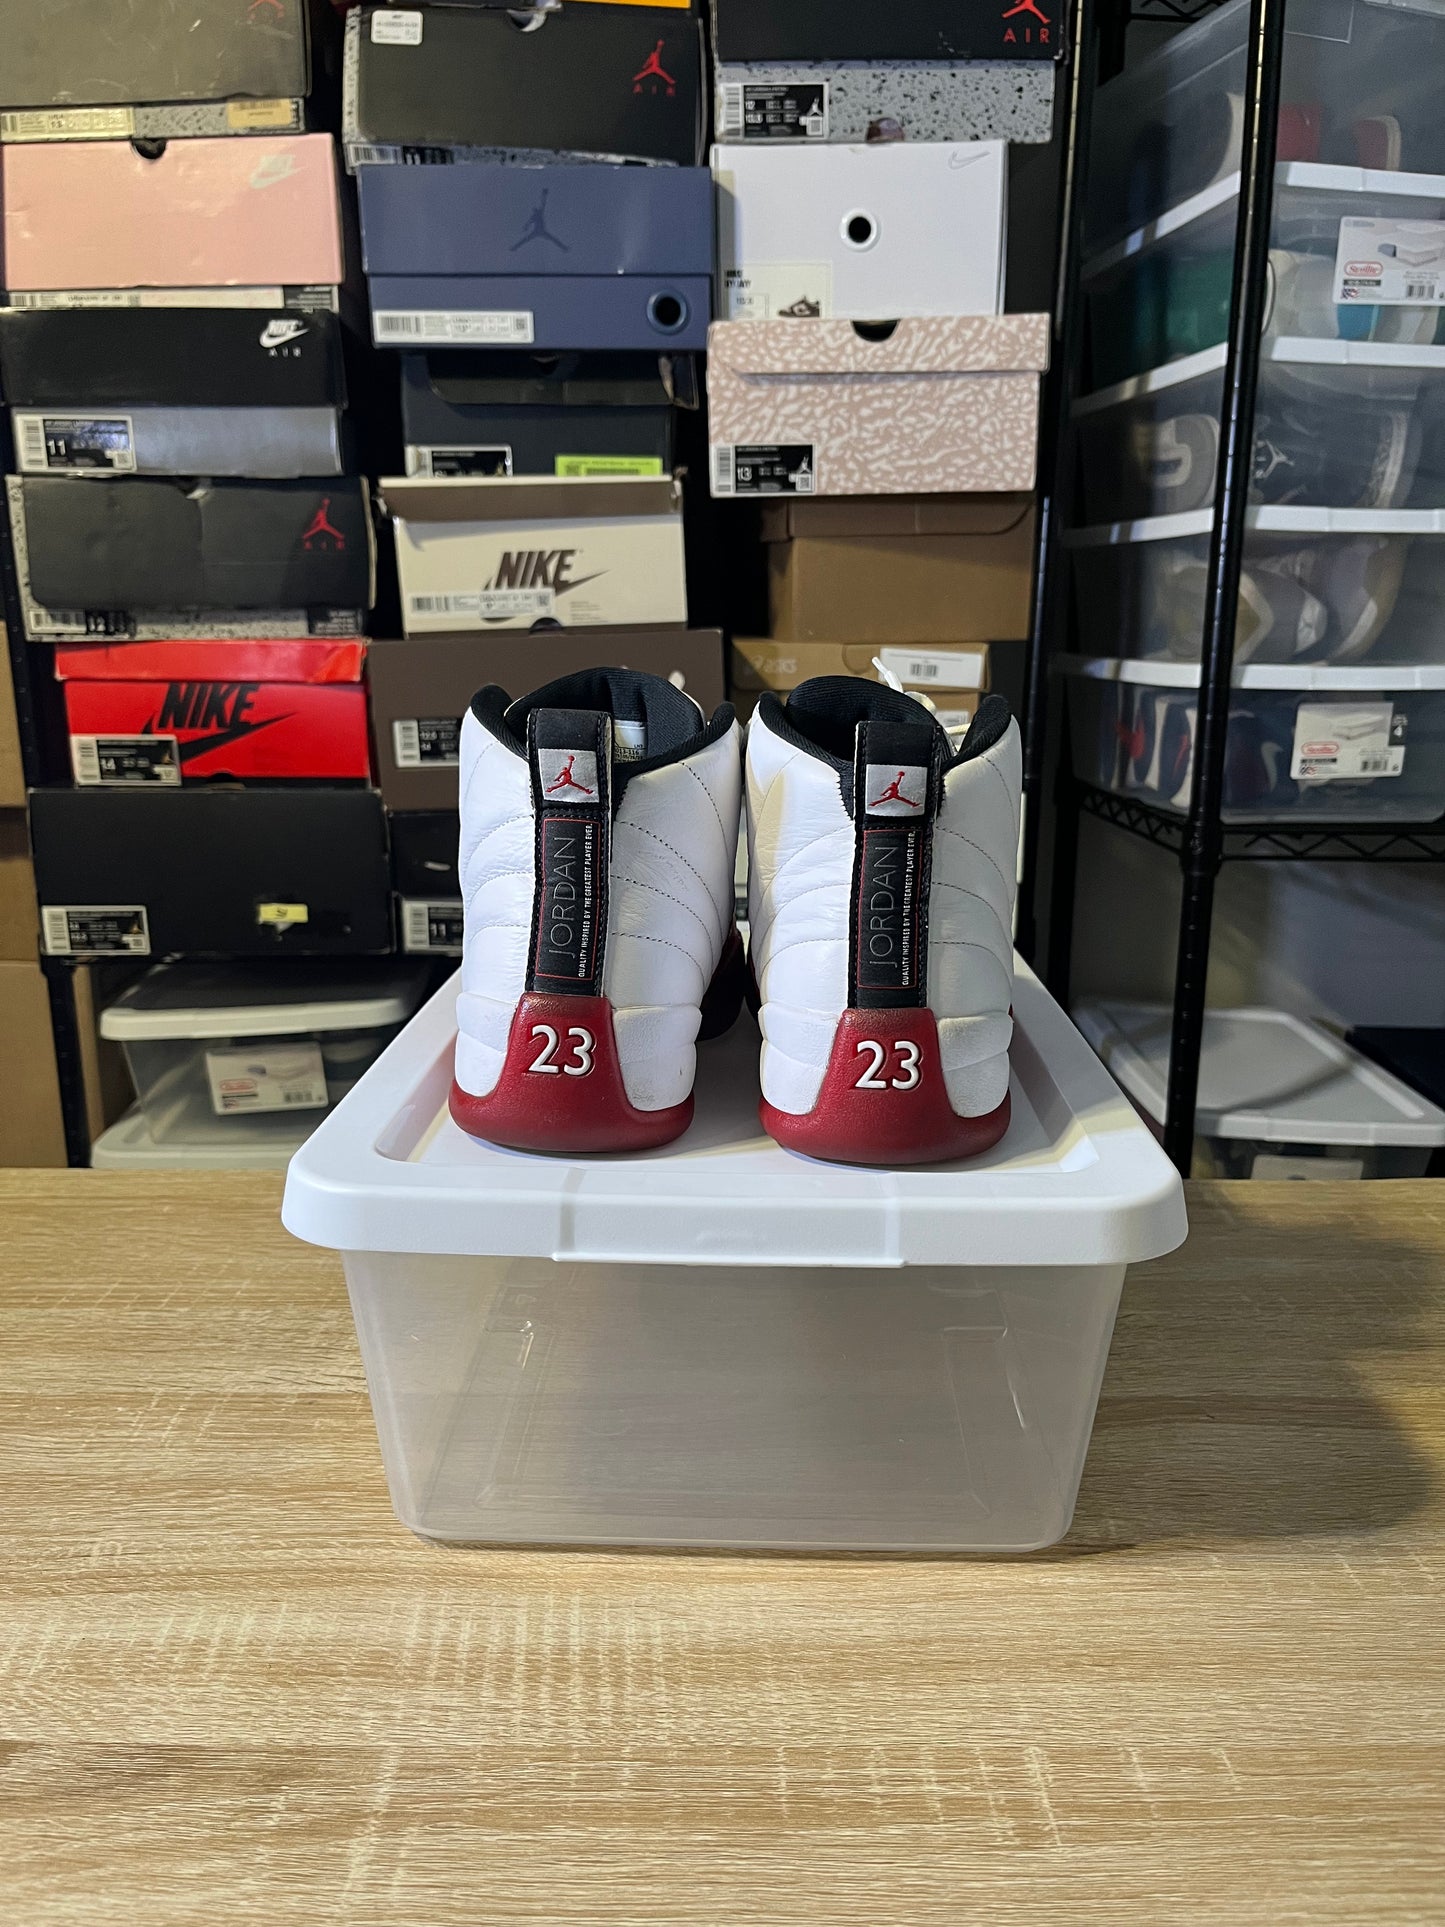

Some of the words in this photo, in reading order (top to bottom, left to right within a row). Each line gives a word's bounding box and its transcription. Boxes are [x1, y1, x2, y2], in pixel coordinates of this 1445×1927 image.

[1003, 27, 1050, 43] AIR
[632, 84, 676, 97] AIR
[268, 347, 302, 358] AIR
[47, 439, 66, 456] 11
[495, 549, 577, 589] NIKE
[158, 682, 261, 730] NIKE
[585, 823, 593, 840] EVER.
[907, 831, 916, 847] EVER.
[584, 841, 593, 865] PLAYER
[905, 848, 914, 872] PLAYER
[584, 866, 592, 897] GREATEST
[903, 874, 913, 905] GREATEST
[549, 837, 577, 959] JORDAN
[584, 898, 592, 908] THE
[869, 846, 898, 968] JORDAN
[903, 905, 911, 916] THE
[583, 909, 592, 919] BY
[902, 918, 911, 927] BY
[581, 920, 591, 948] INSPIRED
[902, 928, 911, 955] INSPIRED
[578, 949, 588, 977] QUALITY
[901, 956, 910, 985] QUALITY
[528, 1024, 593, 1077] 23
[854, 1039, 921, 1091] 23
